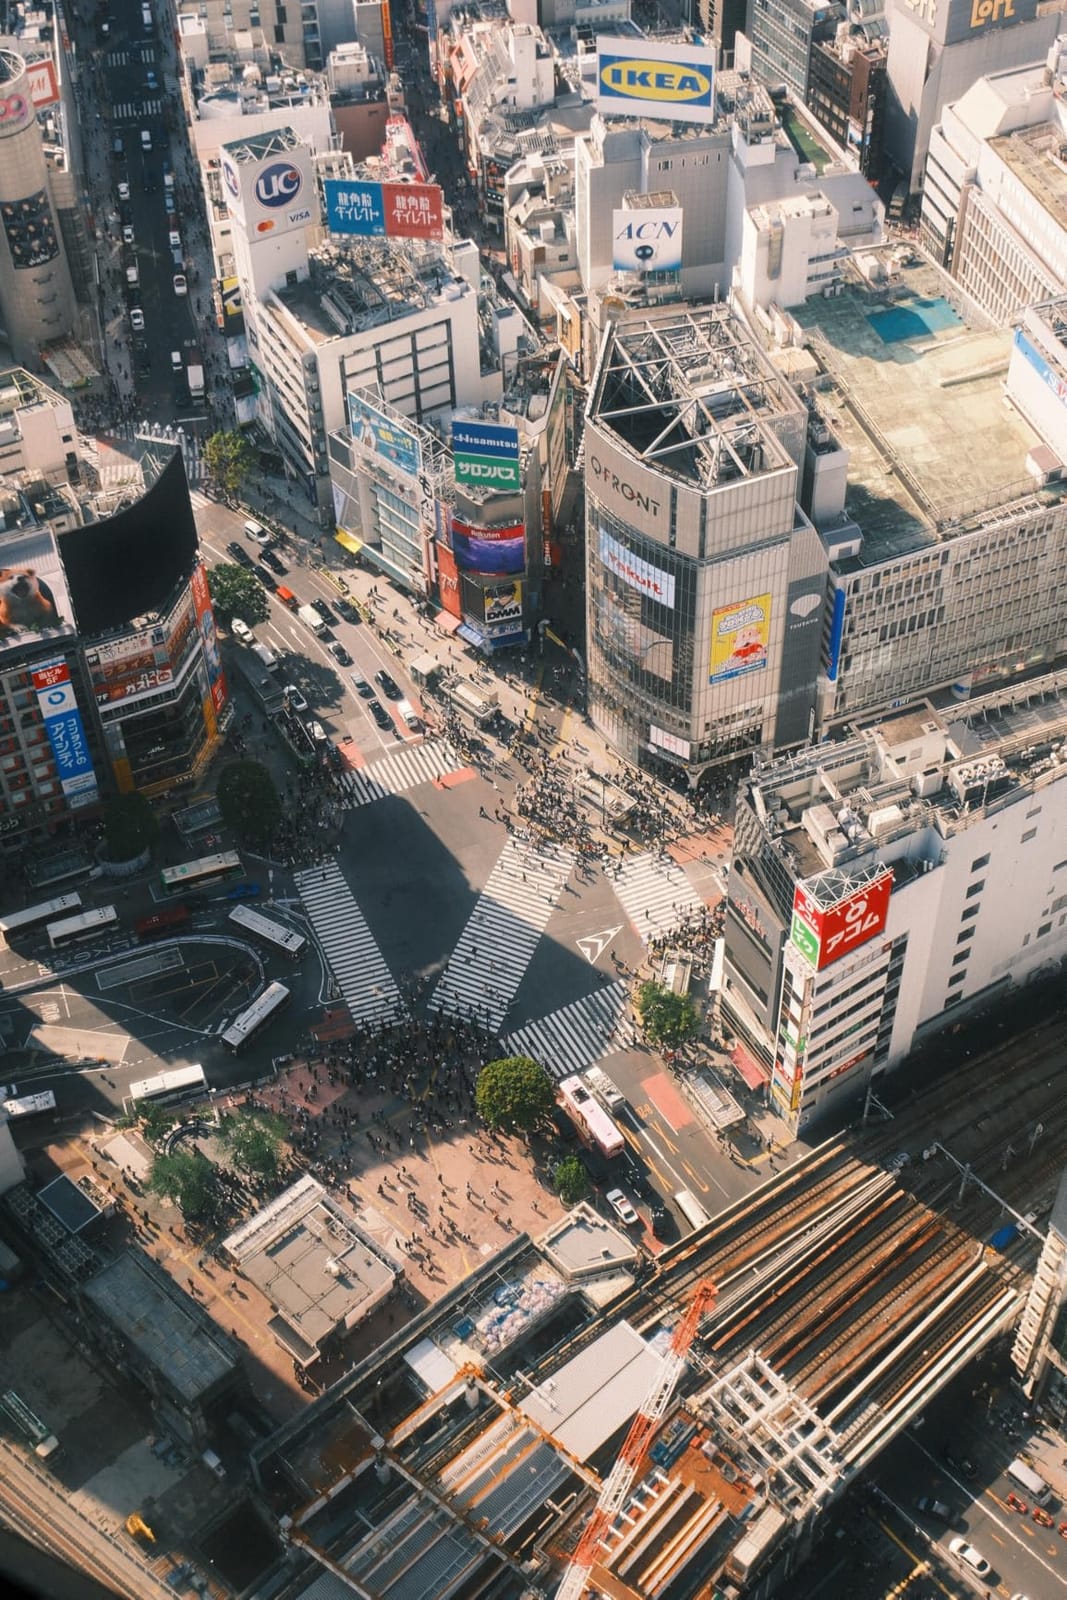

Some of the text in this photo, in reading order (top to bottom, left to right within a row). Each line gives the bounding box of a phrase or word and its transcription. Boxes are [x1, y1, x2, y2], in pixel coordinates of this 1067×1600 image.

[611, 68, 701, 92] IKEA
[289, 211, 310, 222] VISA
[616, 222, 680, 239] ACN
[454, 434, 518, 448] Hisamitsu
[458, 462, 516, 480] サロンパス
[591, 456, 660, 516] QFRONT
[608, 551, 663, 595] Yakult
[487, 608, 520, 620] DMM
[50, 722, 73, 768] アイシティ
[794, 918, 814, 953] レイク
[826, 912, 879, 954] アコム
